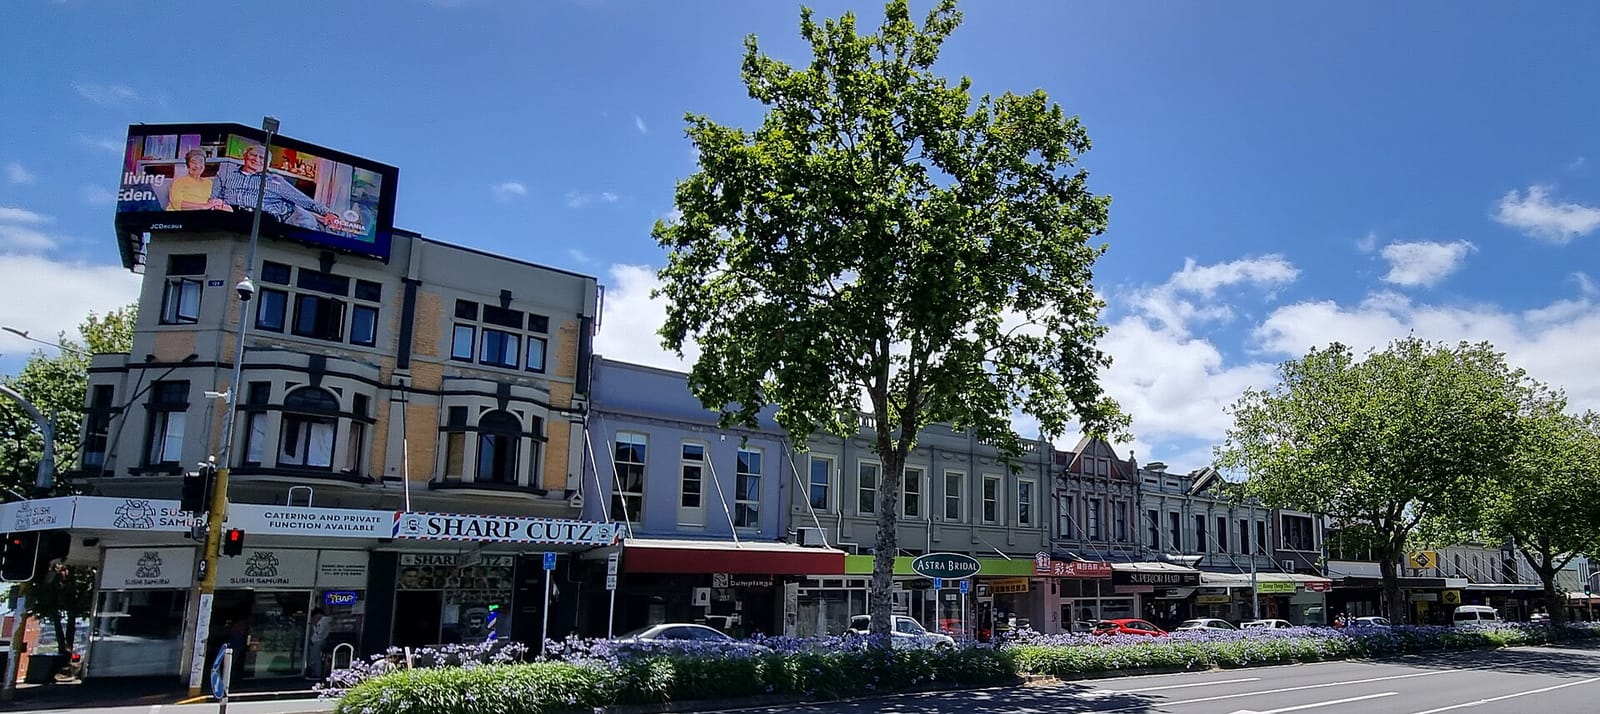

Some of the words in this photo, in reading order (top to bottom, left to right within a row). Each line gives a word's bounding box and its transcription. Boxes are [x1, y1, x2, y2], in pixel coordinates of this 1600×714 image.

[124, 172, 165, 187] living
[334, 220, 366, 231] OCEANIA
[264, 512, 316, 521] CATERING
[320, 514, 341, 522] AND
[343, 515, 381, 523] PRIVATE
[269, 521, 321, 530] FUNCTION
[324, 523, 375, 531] AVAILABLE
[426, 517, 519, 538] SHARP
[526, 523, 593, 542] CUTZ
[917, 560, 945, 571] ASTRA
[948, 560, 977, 572] BRIDAL
[1130, 573, 1164, 584] SUPERIOR
[1164, 573, 1181, 583] HAIR
